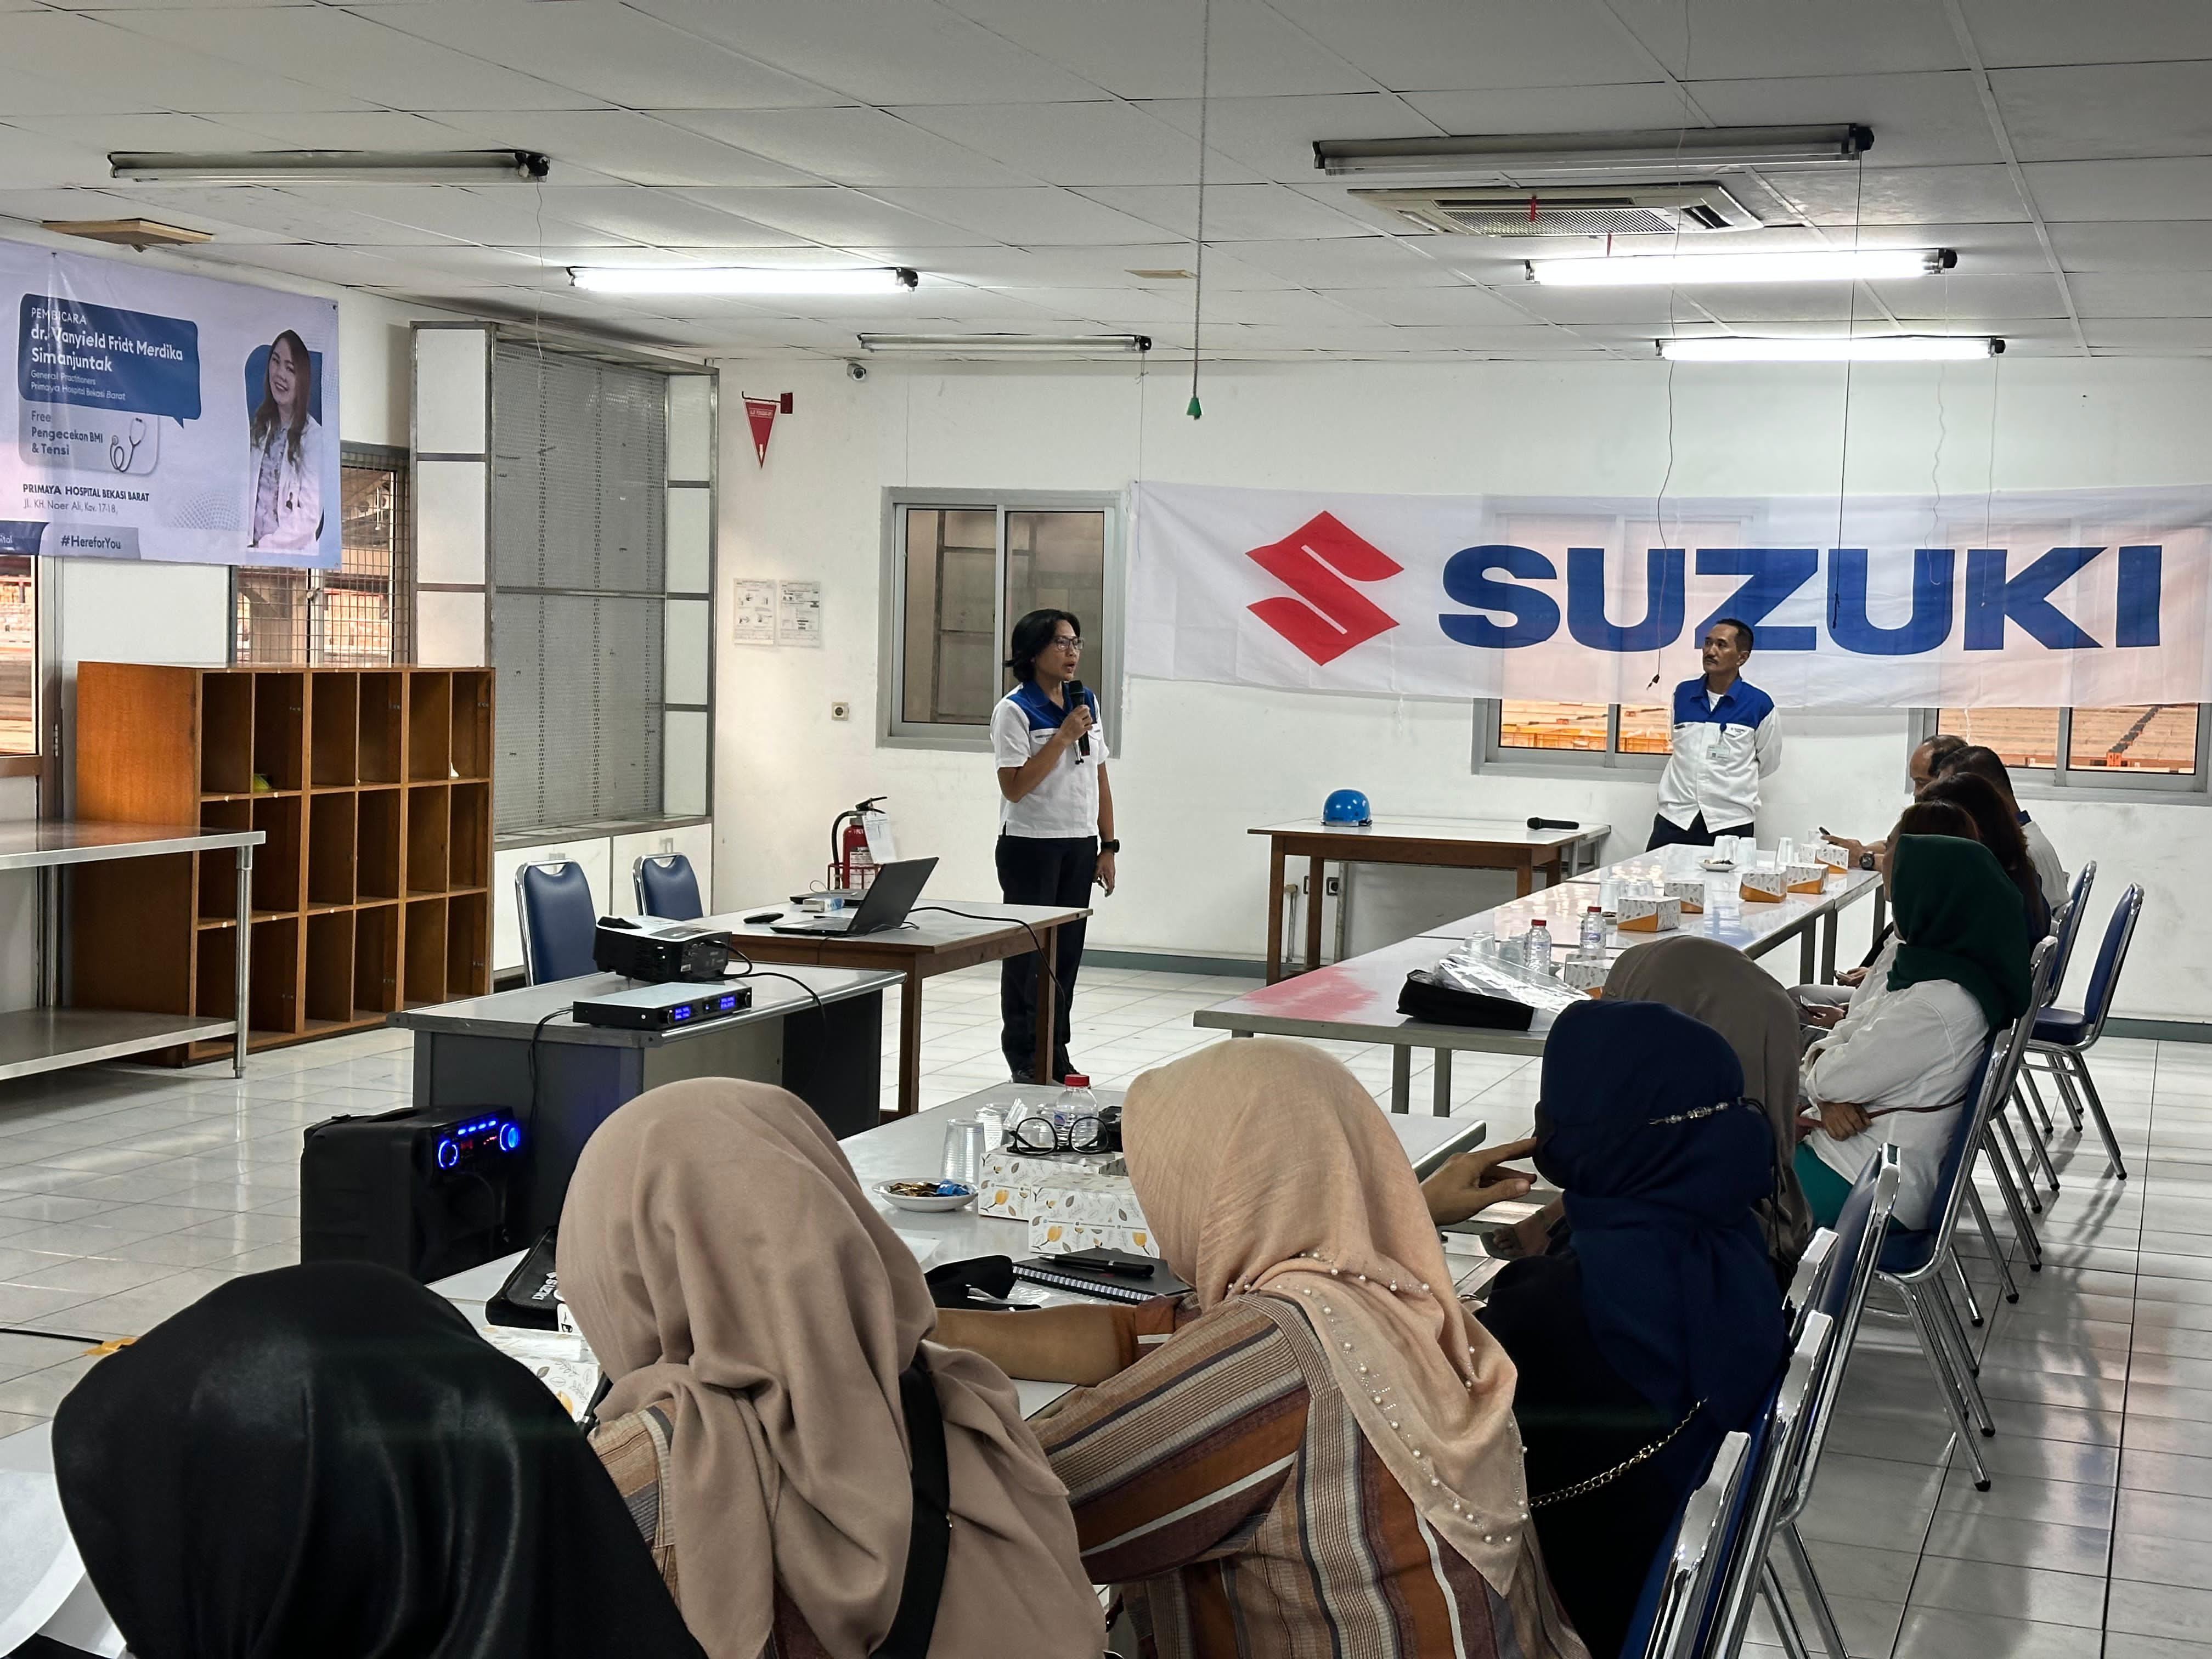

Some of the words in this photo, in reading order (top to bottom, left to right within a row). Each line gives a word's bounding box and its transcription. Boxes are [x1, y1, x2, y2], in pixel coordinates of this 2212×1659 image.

[31, 307, 87, 325] PEMBICARA
[31, 324, 48, 341] dr.
[51, 326, 105, 349] Vanyield
[108, 335, 134, 354] Fridt
[136, 340, 183, 360] Merdika
[31, 347, 112, 372] Simanjuntak
[31, 370, 58, 380] General
[31, 382, 60, 393] Primaya
[106, 390, 126, 401] Barat
[31, 410, 51, 422] Free
[31, 427, 88, 442] Pengecekan
[89, 432, 103, 443] BMI
[32, 443, 39, 453] &
[41, 443, 70, 455] Tensi
[23, 483, 61, 495] PRIMAYA
[65, 486, 101, 498] HOSPITAL
[102, 489, 126, 500] BEKASI
[127, 491, 149, 502] BARAT
[47, 500, 68, 510] Noer
[61, 535, 121, 550] #HereforYou
[1438, 545, 2163, 654] SUZUKI
